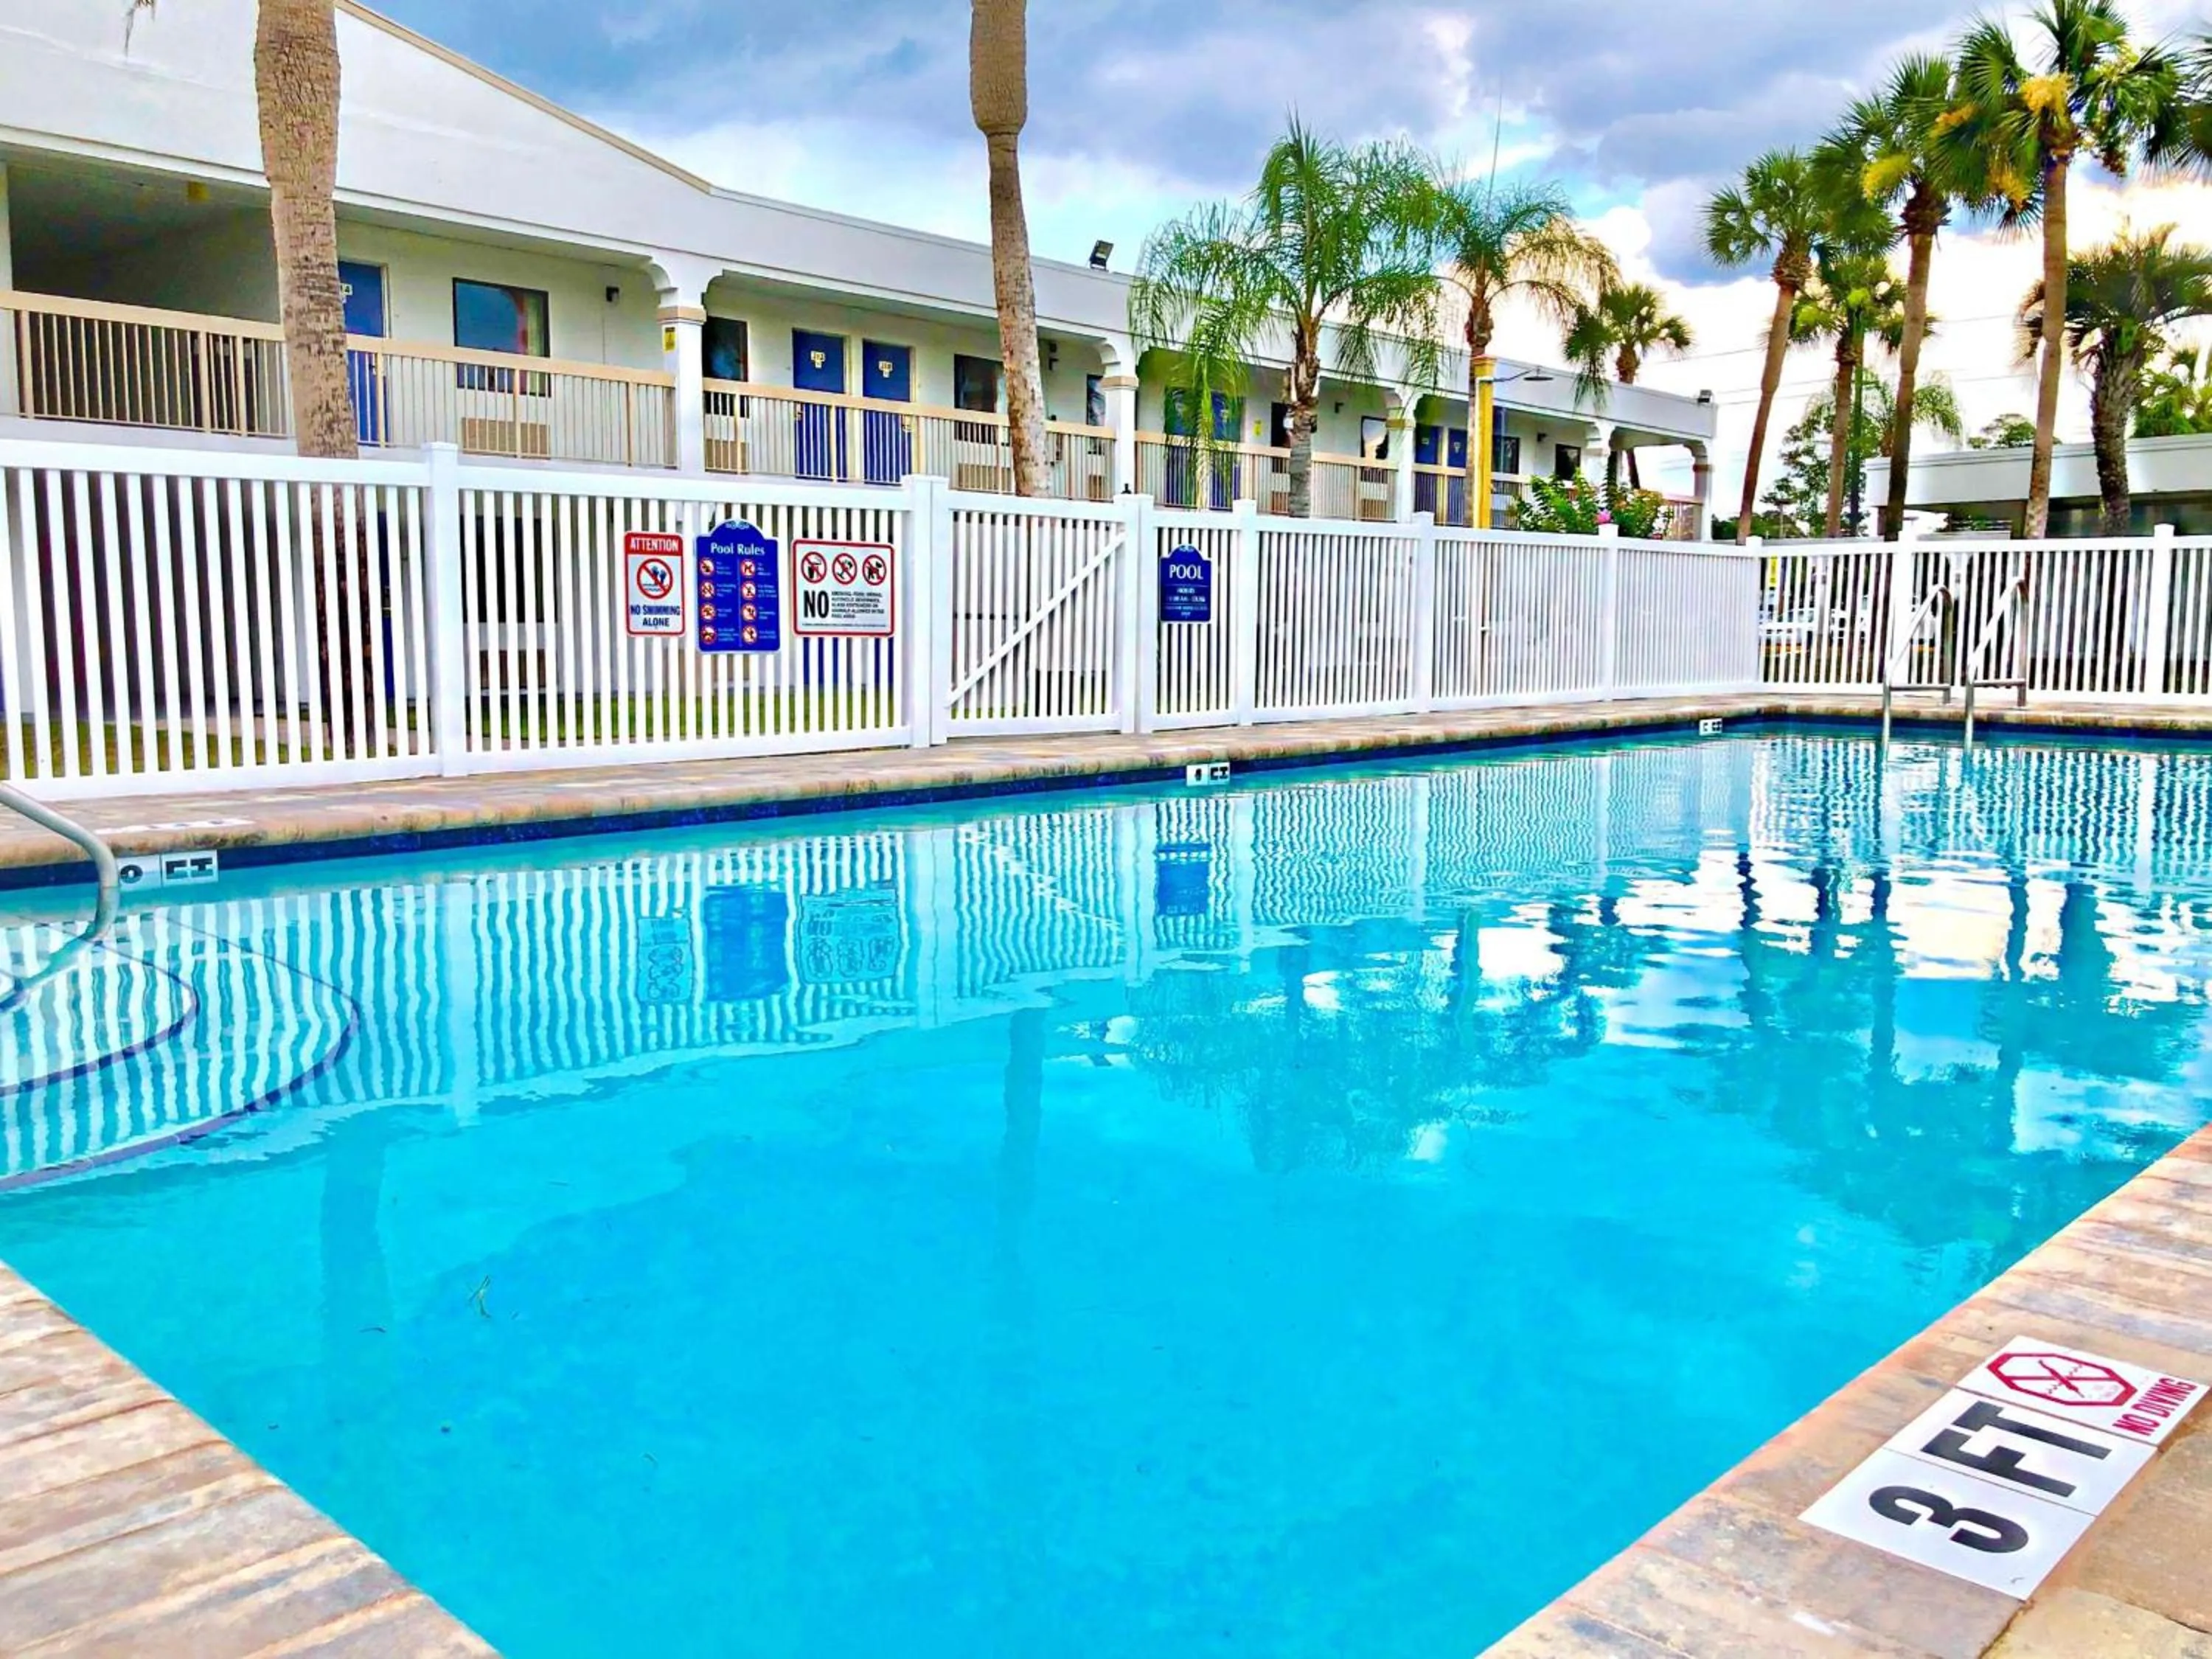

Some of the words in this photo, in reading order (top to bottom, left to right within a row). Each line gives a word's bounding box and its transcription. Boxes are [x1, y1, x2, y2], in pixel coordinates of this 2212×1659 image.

[630, 538, 679, 552] ATTENTION
[710, 542, 734, 554] Pool
[737, 543, 765, 556] Rules
[1169, 564, 1203, 580] POOL
[630, 605, 641, 615] NO
[642, 605, 681, 616] SWIMMING
[804, 590, 830, 619] NO
[642, 617, 670, 627] ALONE
[2131, 1378, 2198, 1419] DIVING
[2112, 1413, 2161, 1437] NO
[1921, 1400, 2112, 1498] FT
[1868, 1486, 2029, 1554] 3
